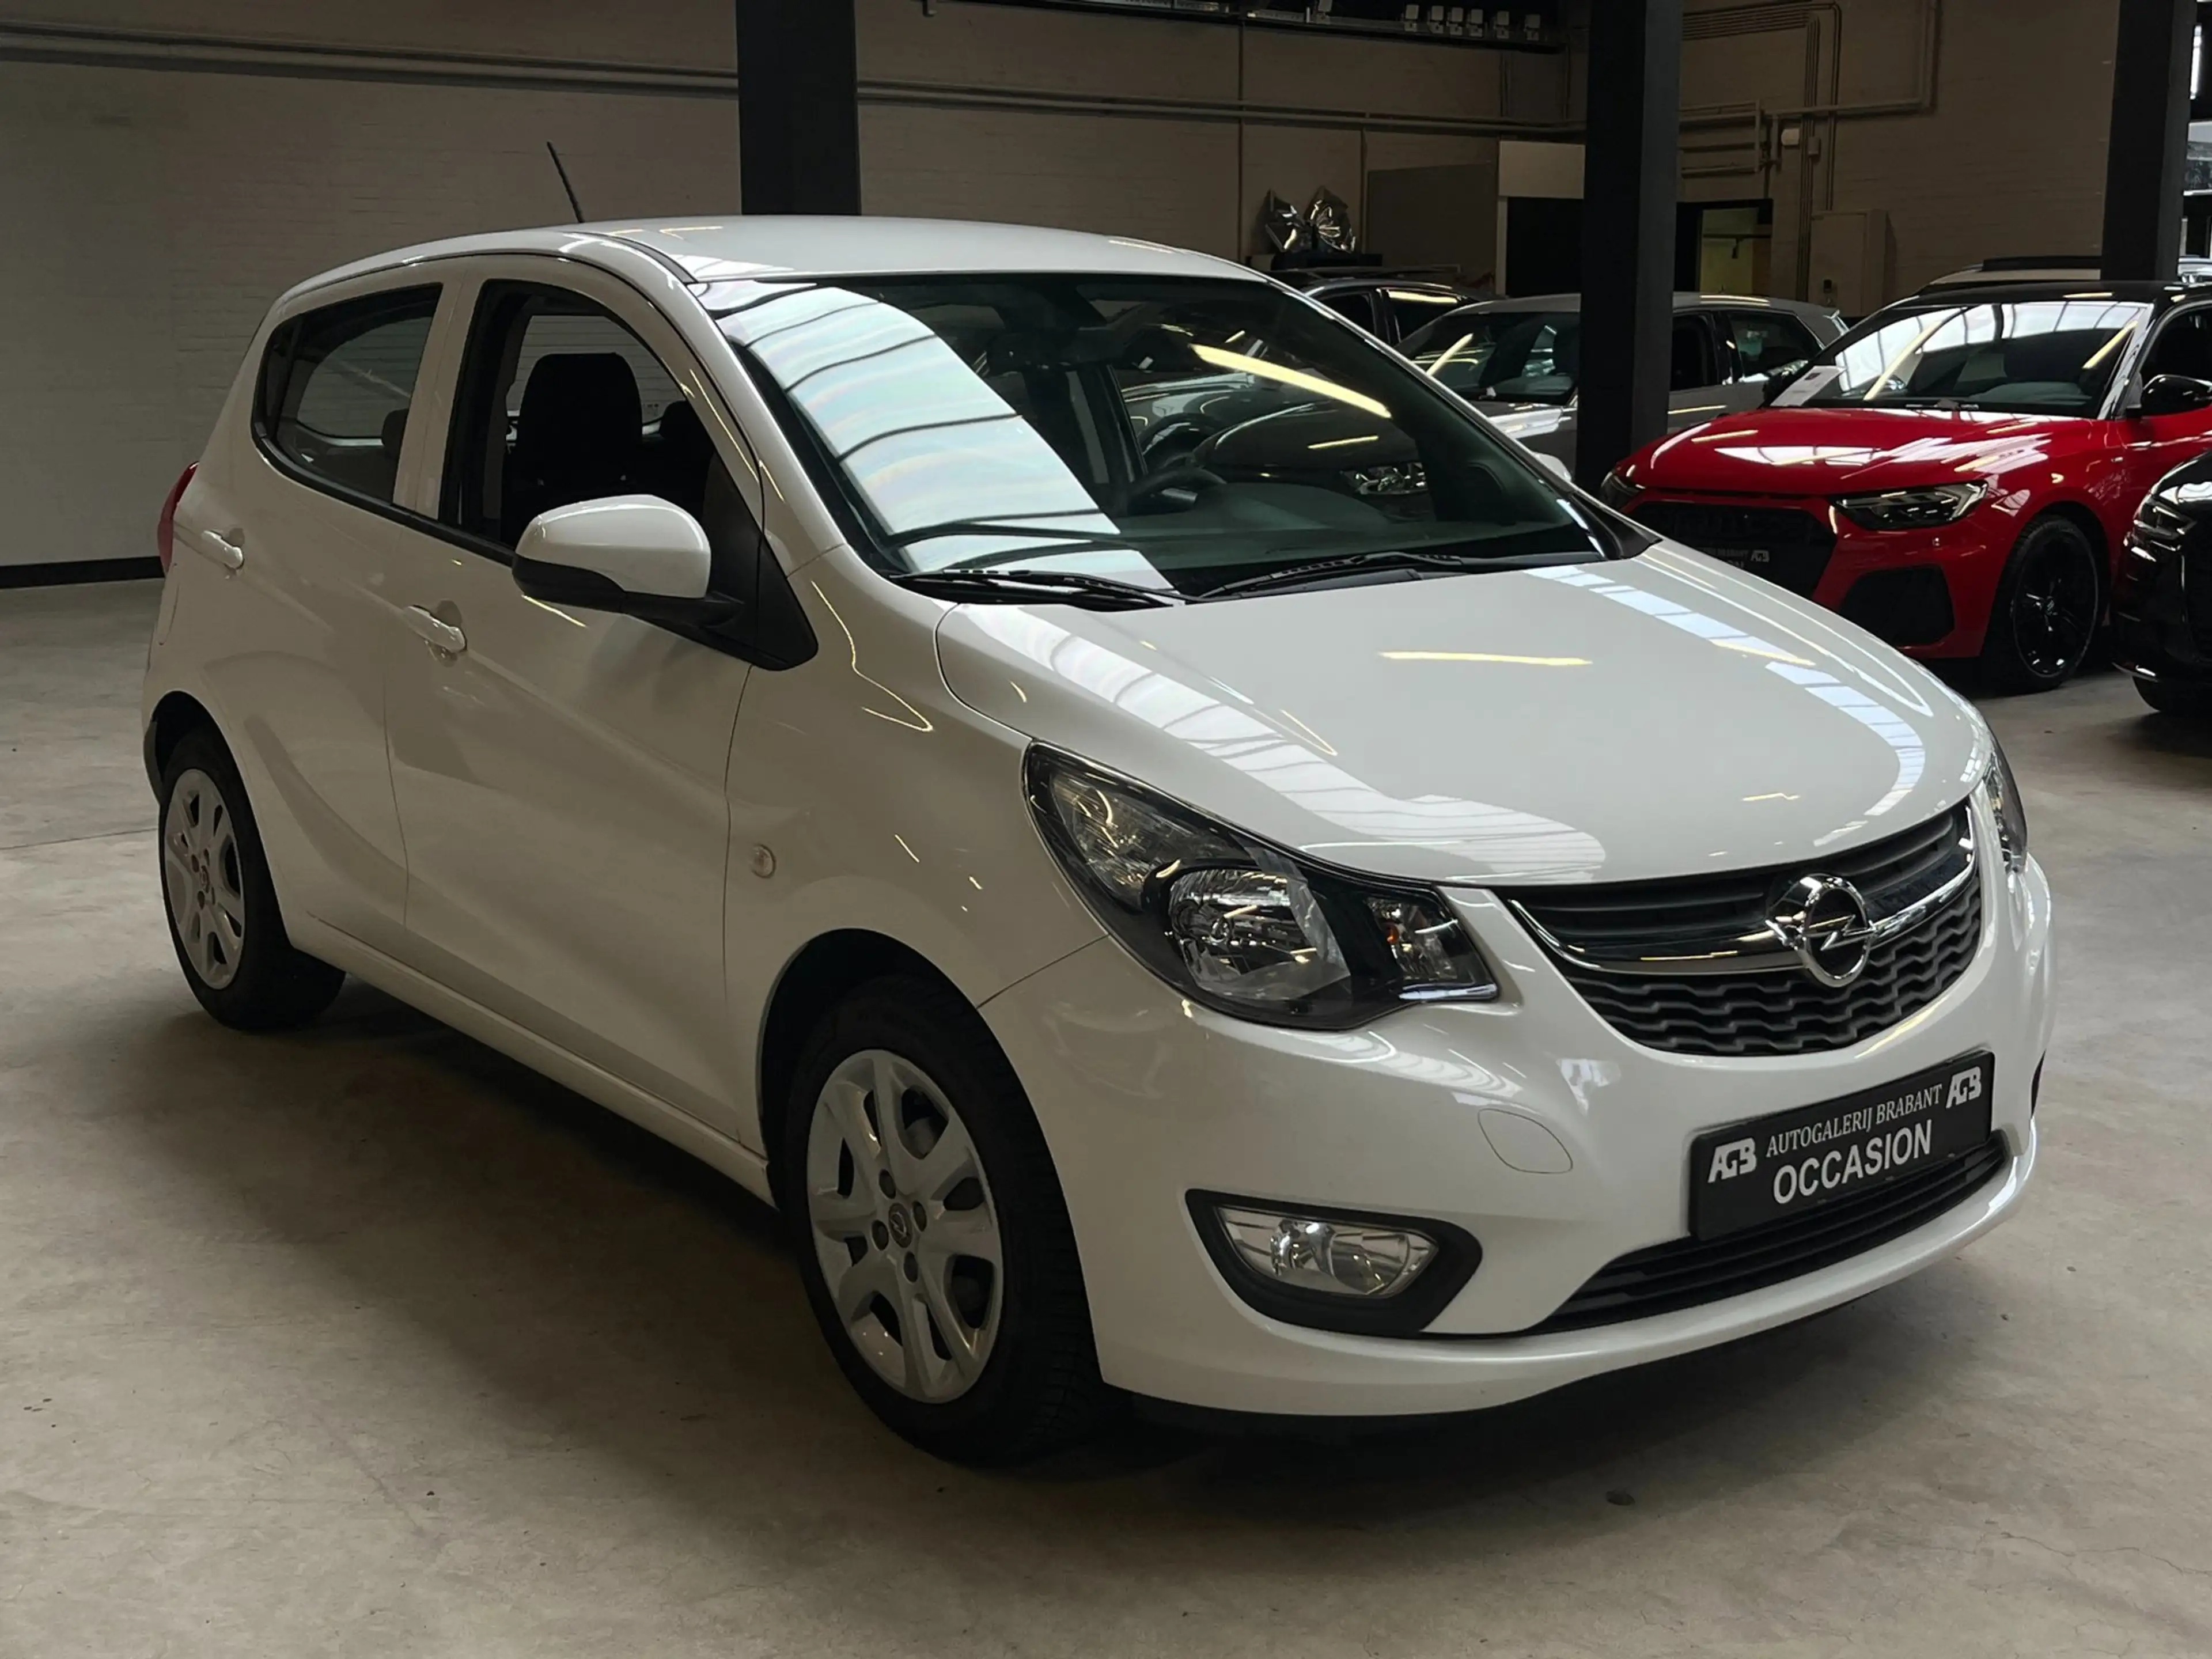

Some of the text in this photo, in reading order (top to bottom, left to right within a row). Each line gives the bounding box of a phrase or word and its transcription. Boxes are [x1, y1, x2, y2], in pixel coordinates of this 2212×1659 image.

[1708, 1066, 1982, 1183] AGB AUTOGALERIJ BRABANT AGB
[1773, 1119, 1933, 1204] OCCASION
